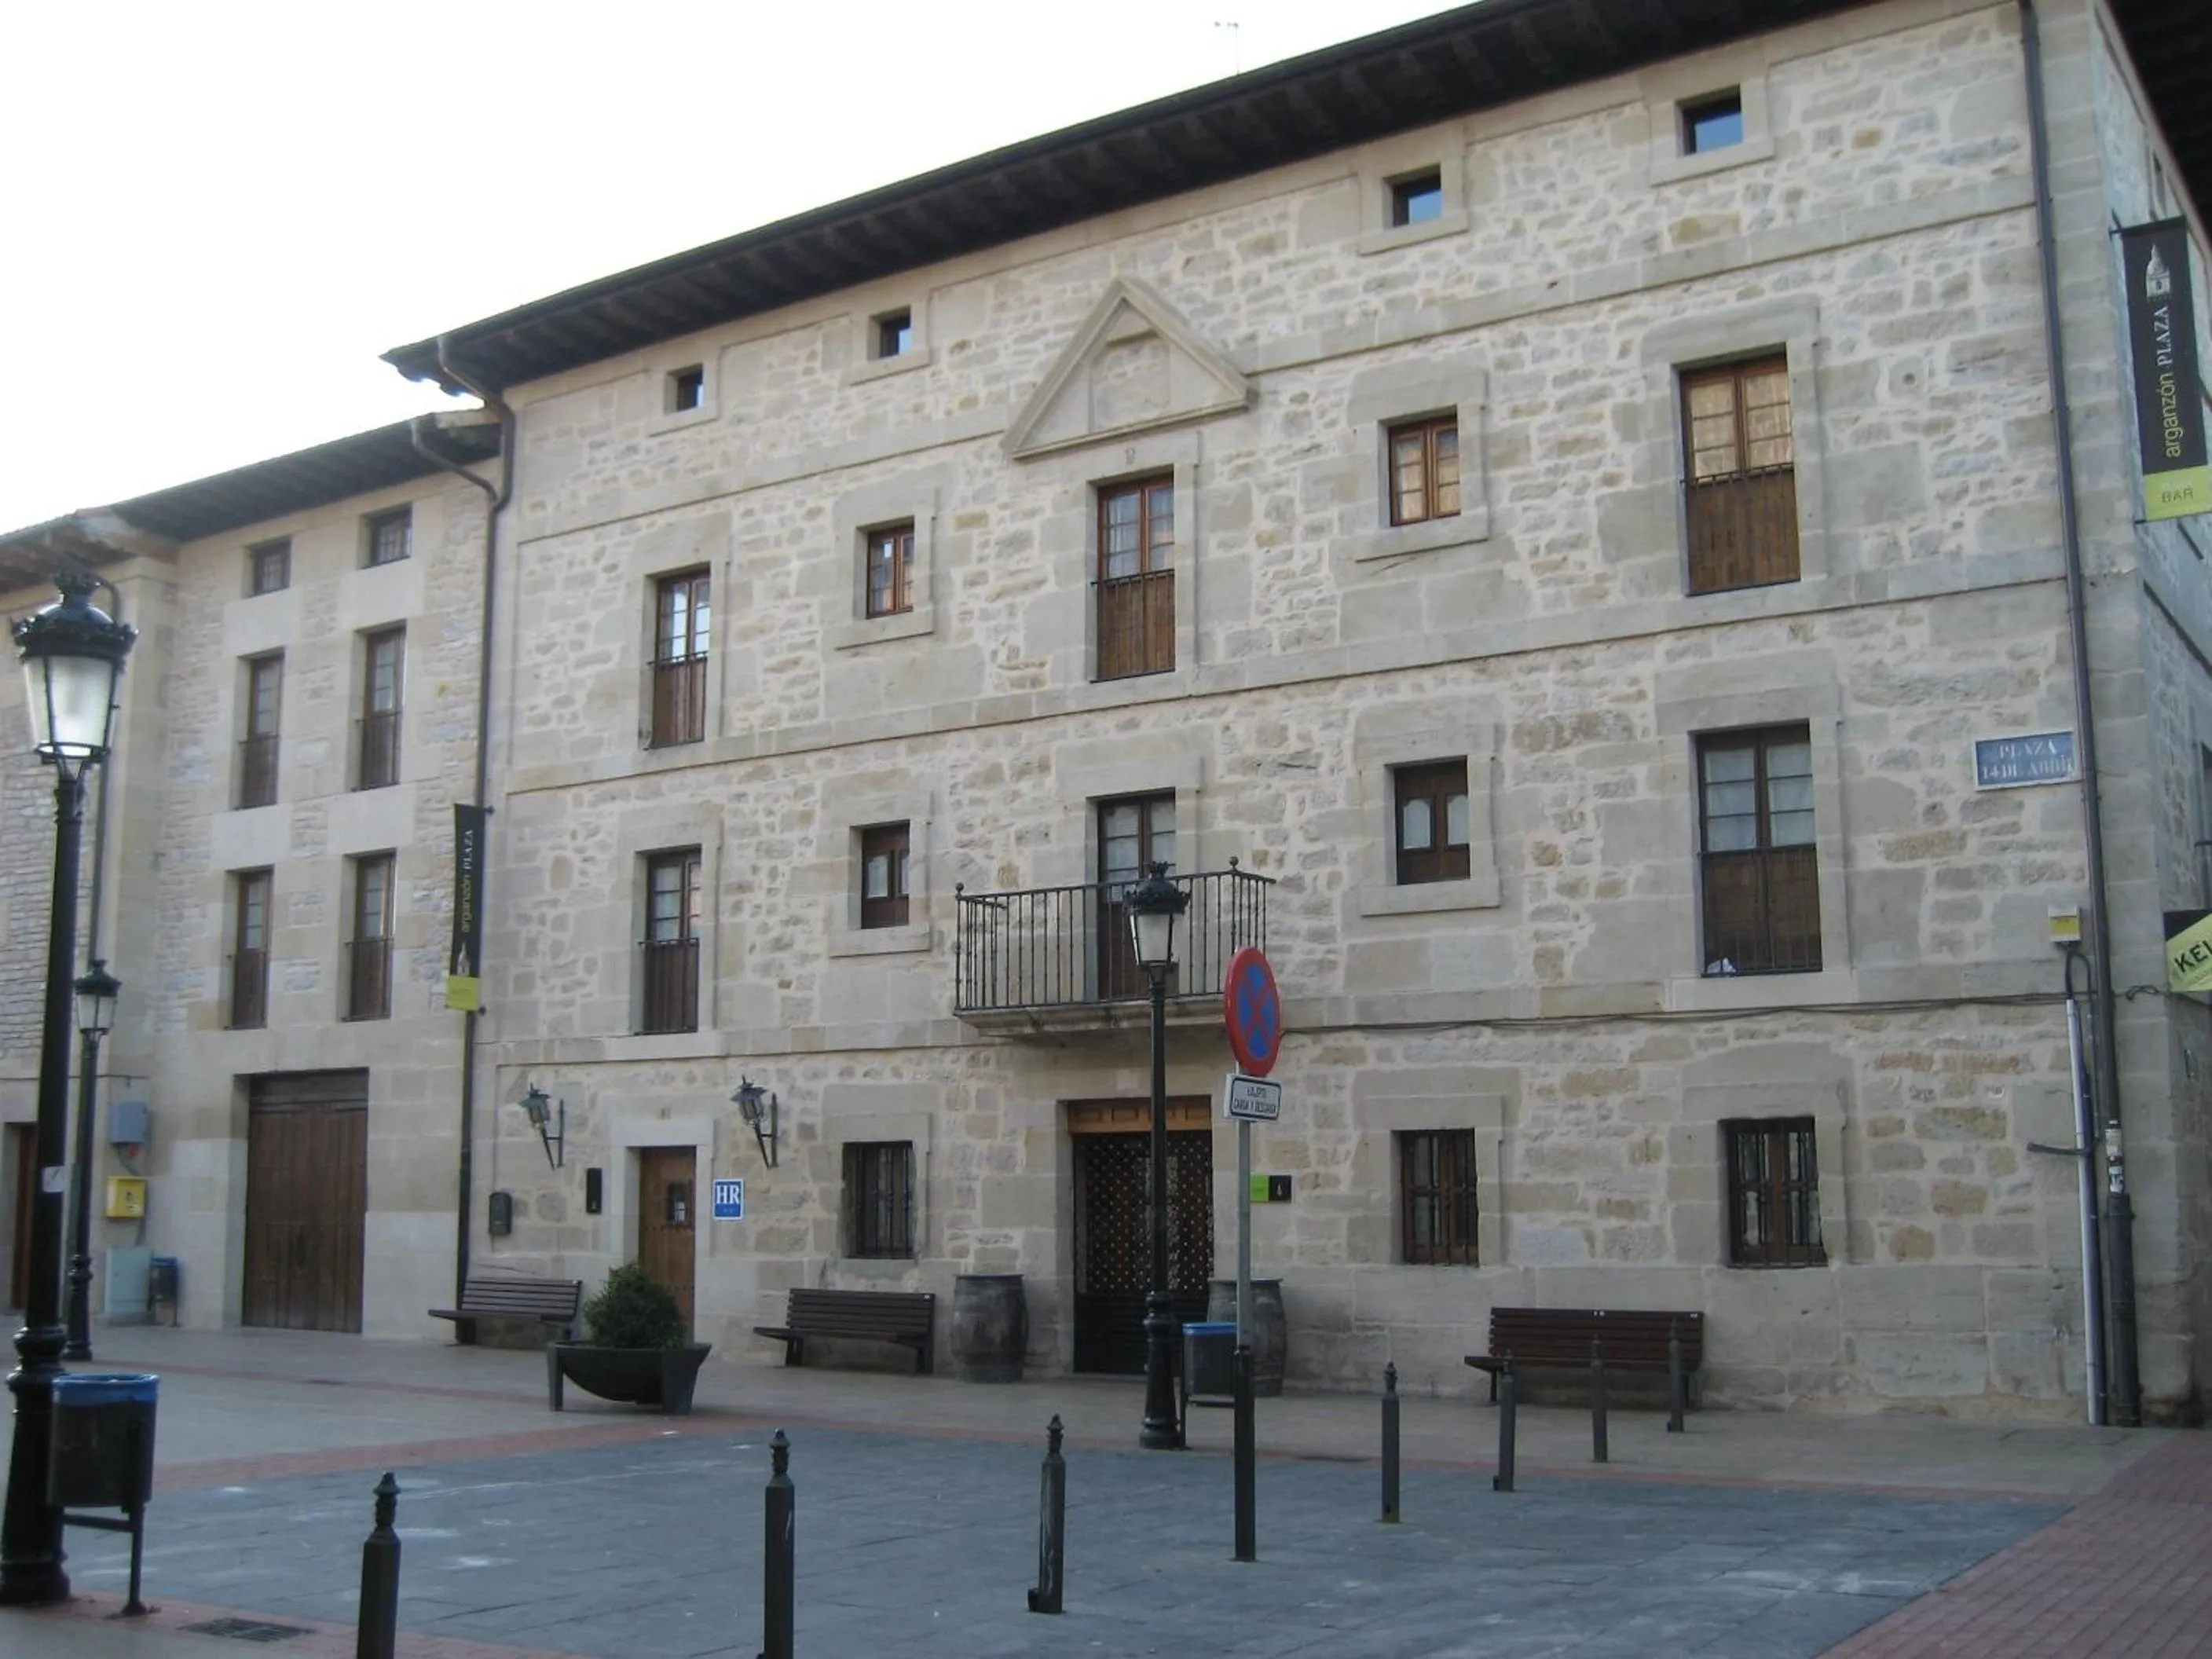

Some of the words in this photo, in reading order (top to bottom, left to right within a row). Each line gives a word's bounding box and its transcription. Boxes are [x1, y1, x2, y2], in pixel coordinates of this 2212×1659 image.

[2153, 306, 2174, 367] PLAZA
[2156, 372, 2184, 459] arganzón
[2161, 487, 2194, 504] BAR
[716, 1185, 740, 1204] HR
